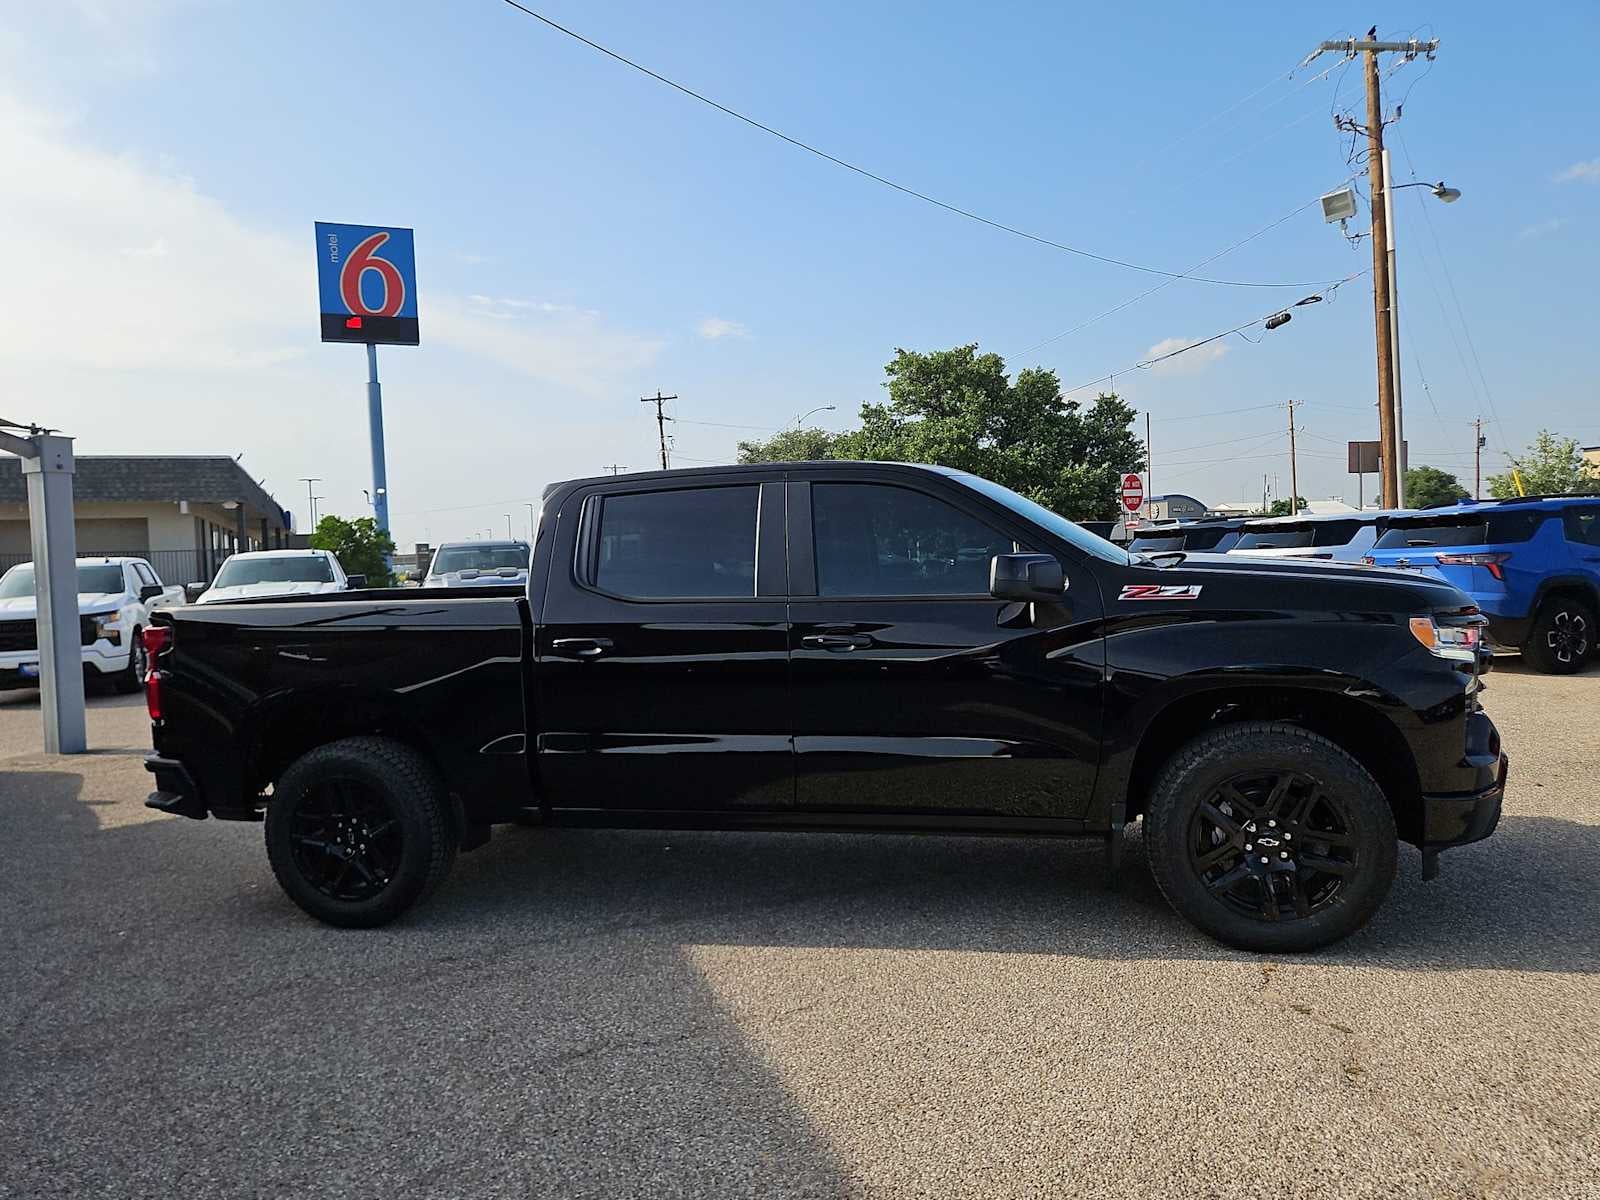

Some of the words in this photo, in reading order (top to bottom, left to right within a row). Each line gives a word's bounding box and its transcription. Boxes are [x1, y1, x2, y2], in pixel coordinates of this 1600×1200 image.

[328, 233, 339, 263] motel
[340, 232, 406, 318] 6
[1117, 585, 1203, 601] Z71
